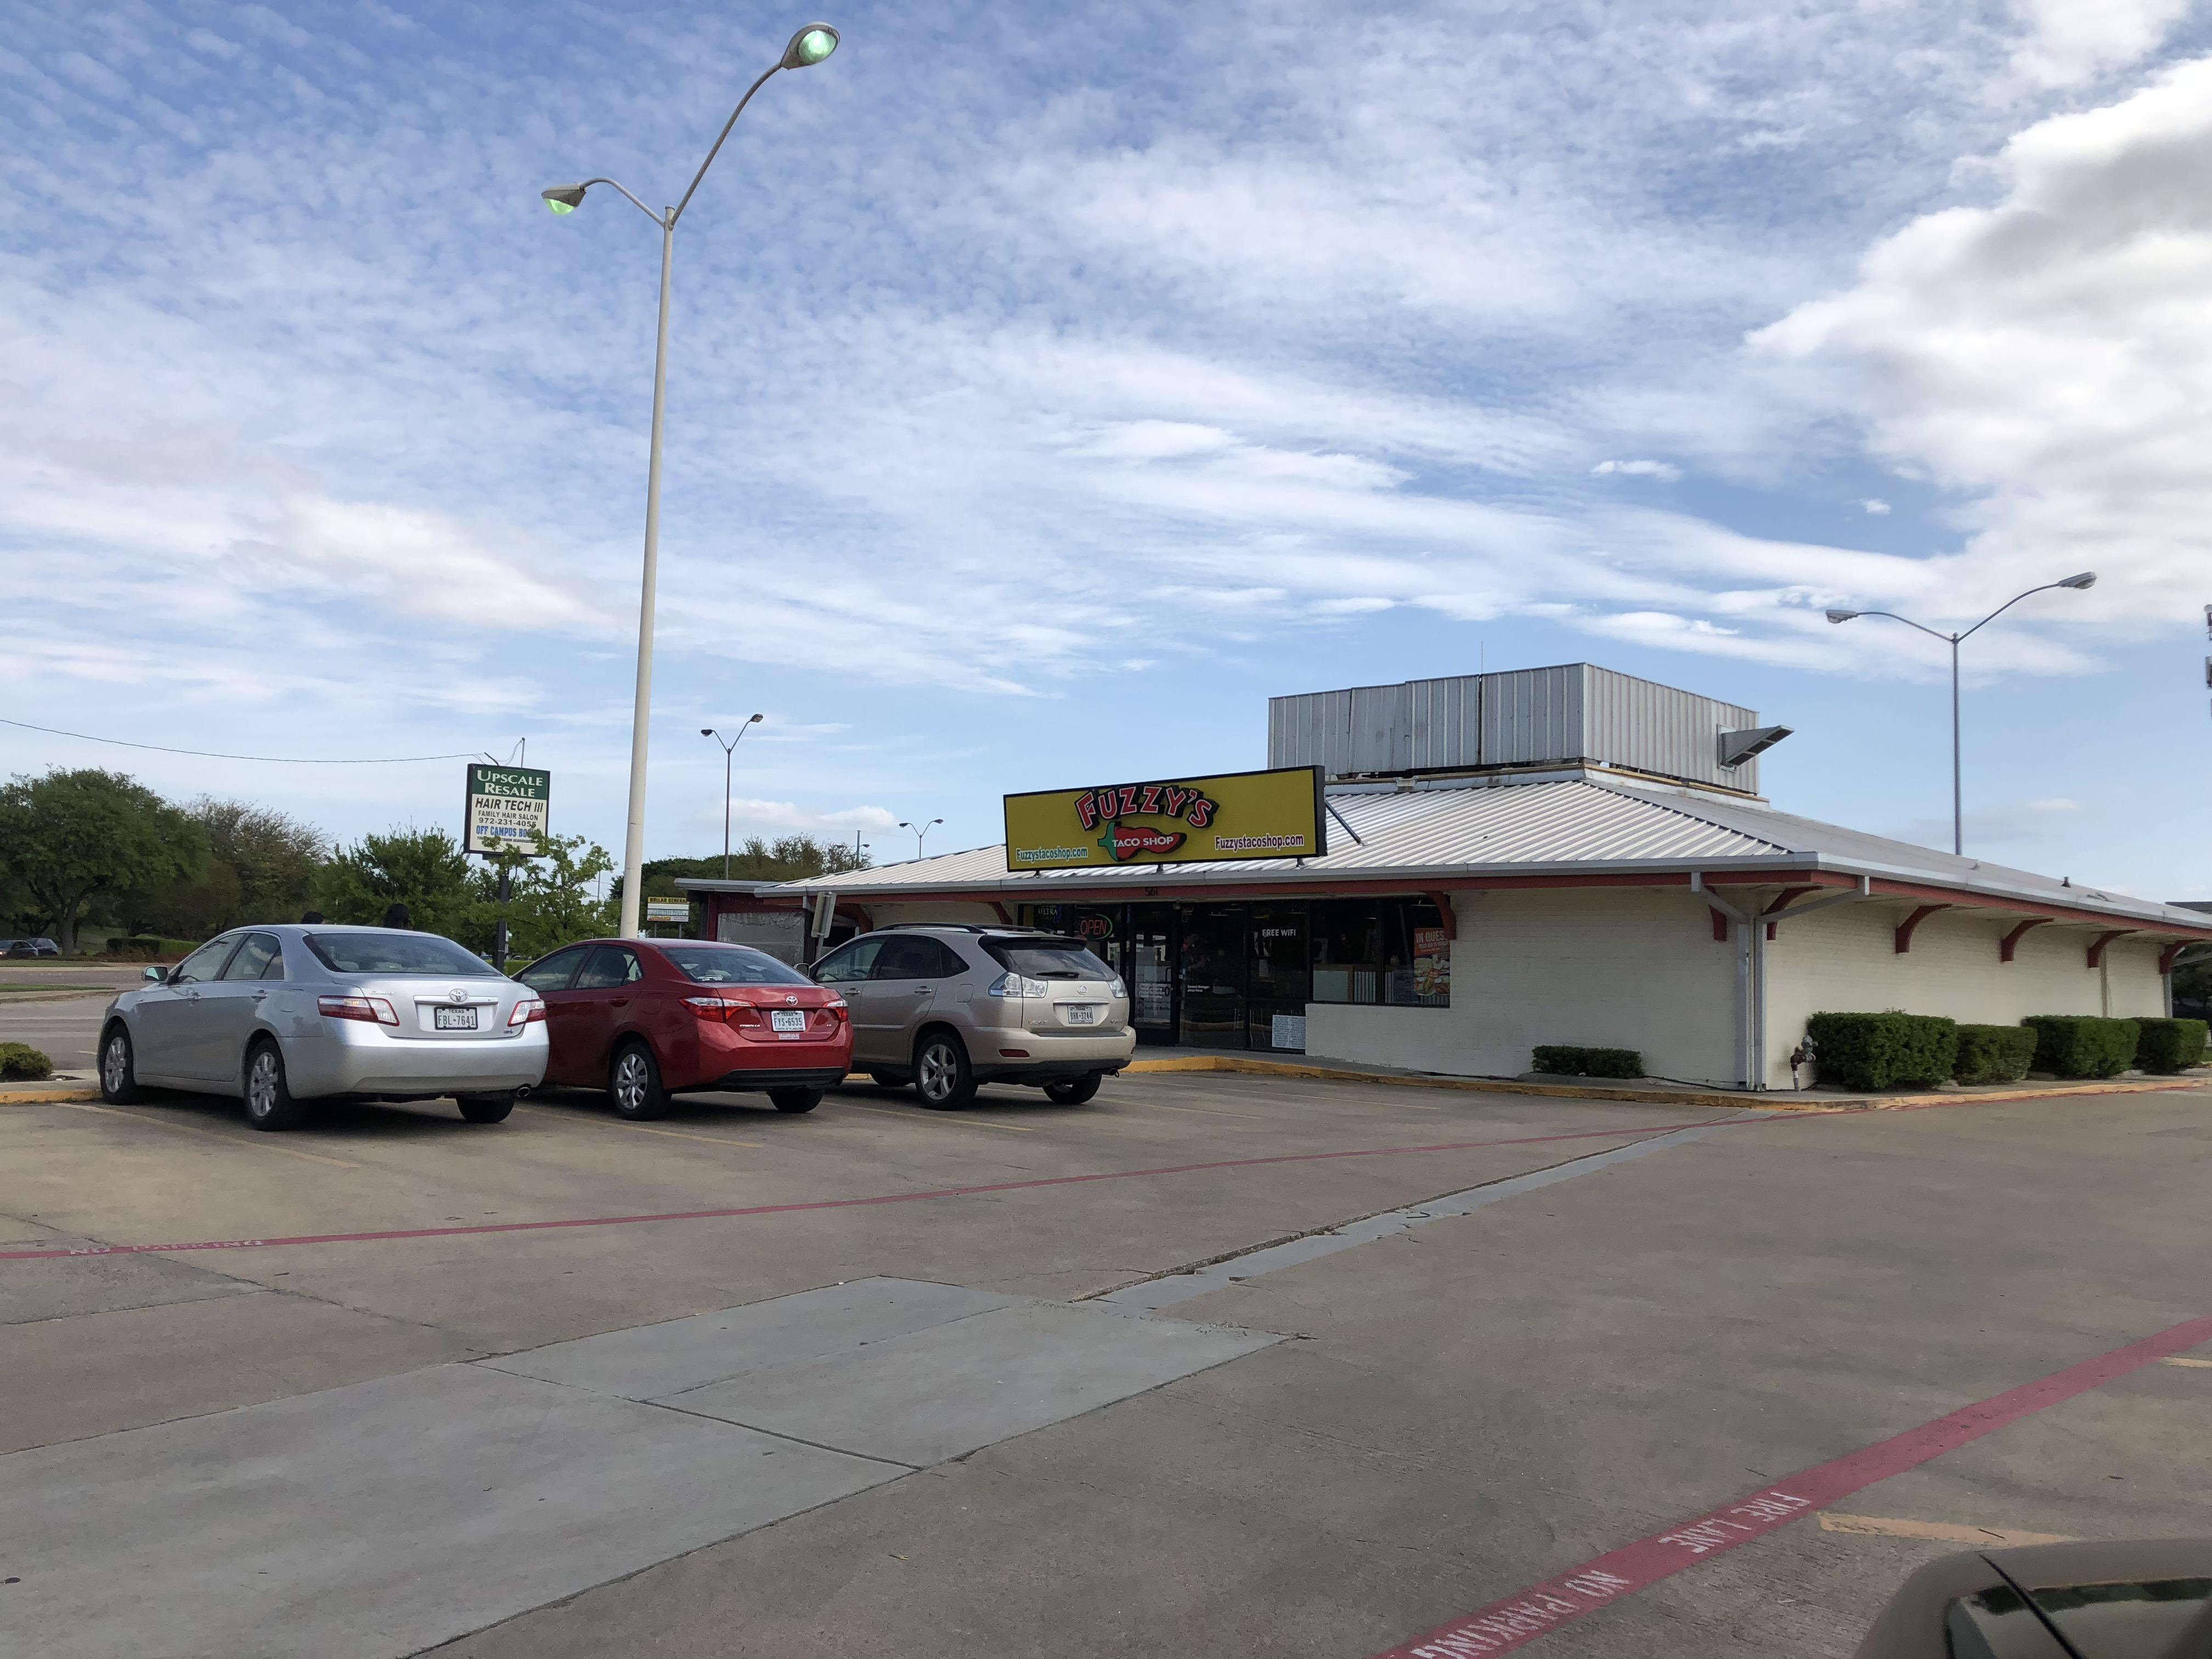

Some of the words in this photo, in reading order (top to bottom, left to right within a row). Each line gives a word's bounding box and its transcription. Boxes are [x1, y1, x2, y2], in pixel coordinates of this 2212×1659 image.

[477, 770, 543, 786] UPSCALE
[485, 782, 535, 797] RESALE
[475, 798, 501, 809] HAIR
[505, 800, 532, 811] TECH
[1075, 785, 1215, 831] FUZZY'S
[479, 817, 537, 827] 972-231-4055
[476, 825, 488, 834] OFF
[490, 826, 516, 837] CAMPUS
[1112, 838, 1141, 848] TACO
[1143, 836, 1174, 845] SHOP
[1215, 833, 1305, 853] Fuzzystacoshop.com
[1016, 847, 1088, 863] Fuzzystacoshop.com
[1080, 919, 1108, 935] OPEN
[1416, 933, 1424, 943] IN
[1426, 930, 1448, 942] QUES
[1731, 1491, 1810, 1522] FIRE
[1657, 1519, 1752, 1554] LANE
[1565, 1569, 1630, 1598] NO
[1410, 1593, 1581, 1659] PARKING
